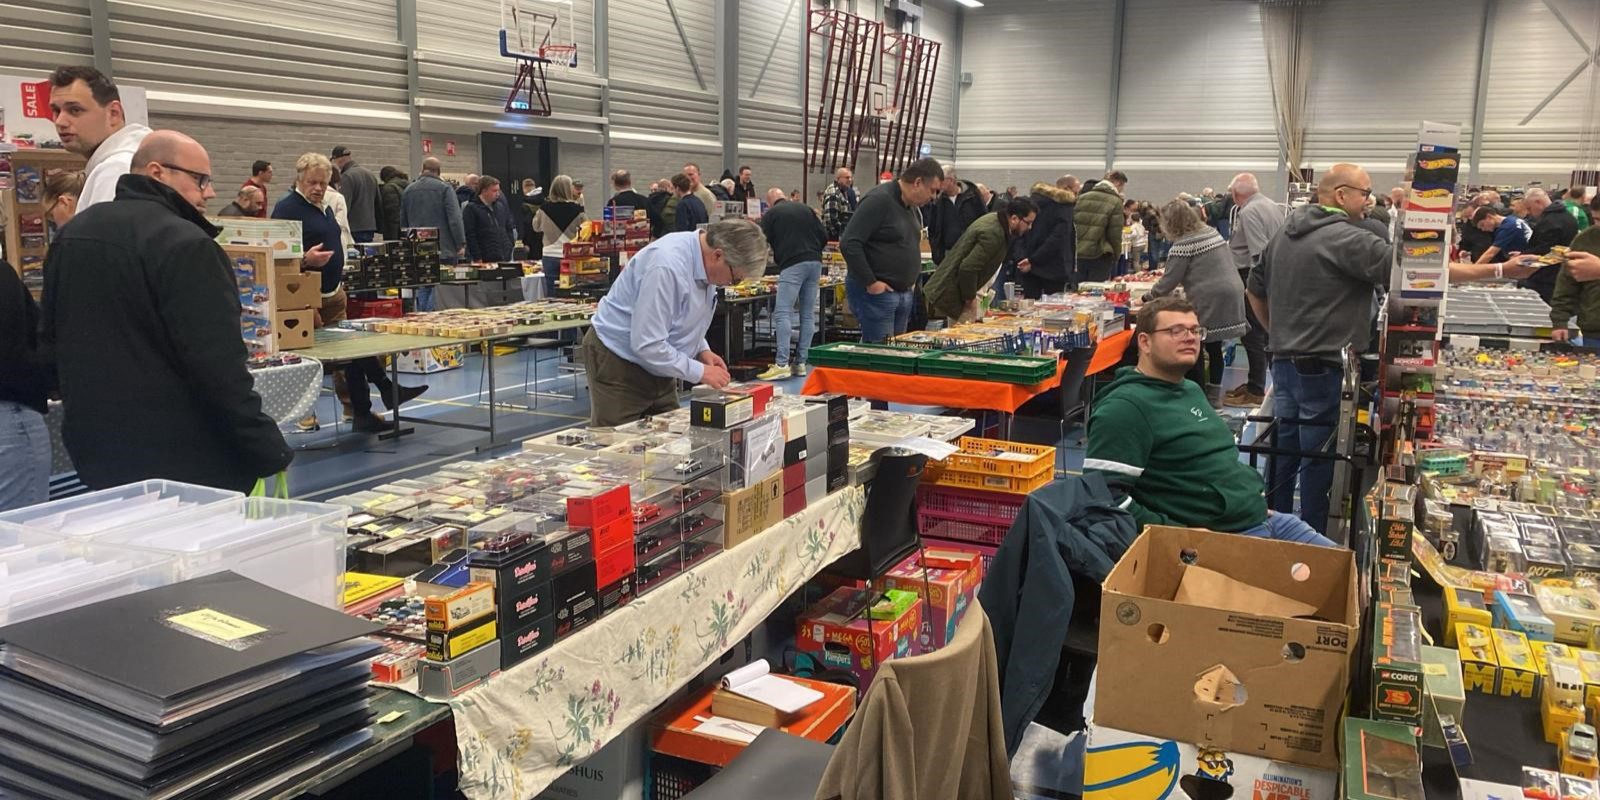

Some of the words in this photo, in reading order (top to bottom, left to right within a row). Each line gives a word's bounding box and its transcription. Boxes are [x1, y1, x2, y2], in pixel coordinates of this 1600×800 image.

[25, 84, 37, 117] SALE
[1407, 216, 1444, 225] NISSAN
[832, 631, 853, 645] MEGA
[1315, 635, 1348, 649] PORT
[825, 650, 851, 666] Pampers
[1391, 672, 1418, 683] CORGI
[1263, 773, 1303, 787] ILLUMINATION'S
[1254, 782, 1312, 799] DESPICABLE
